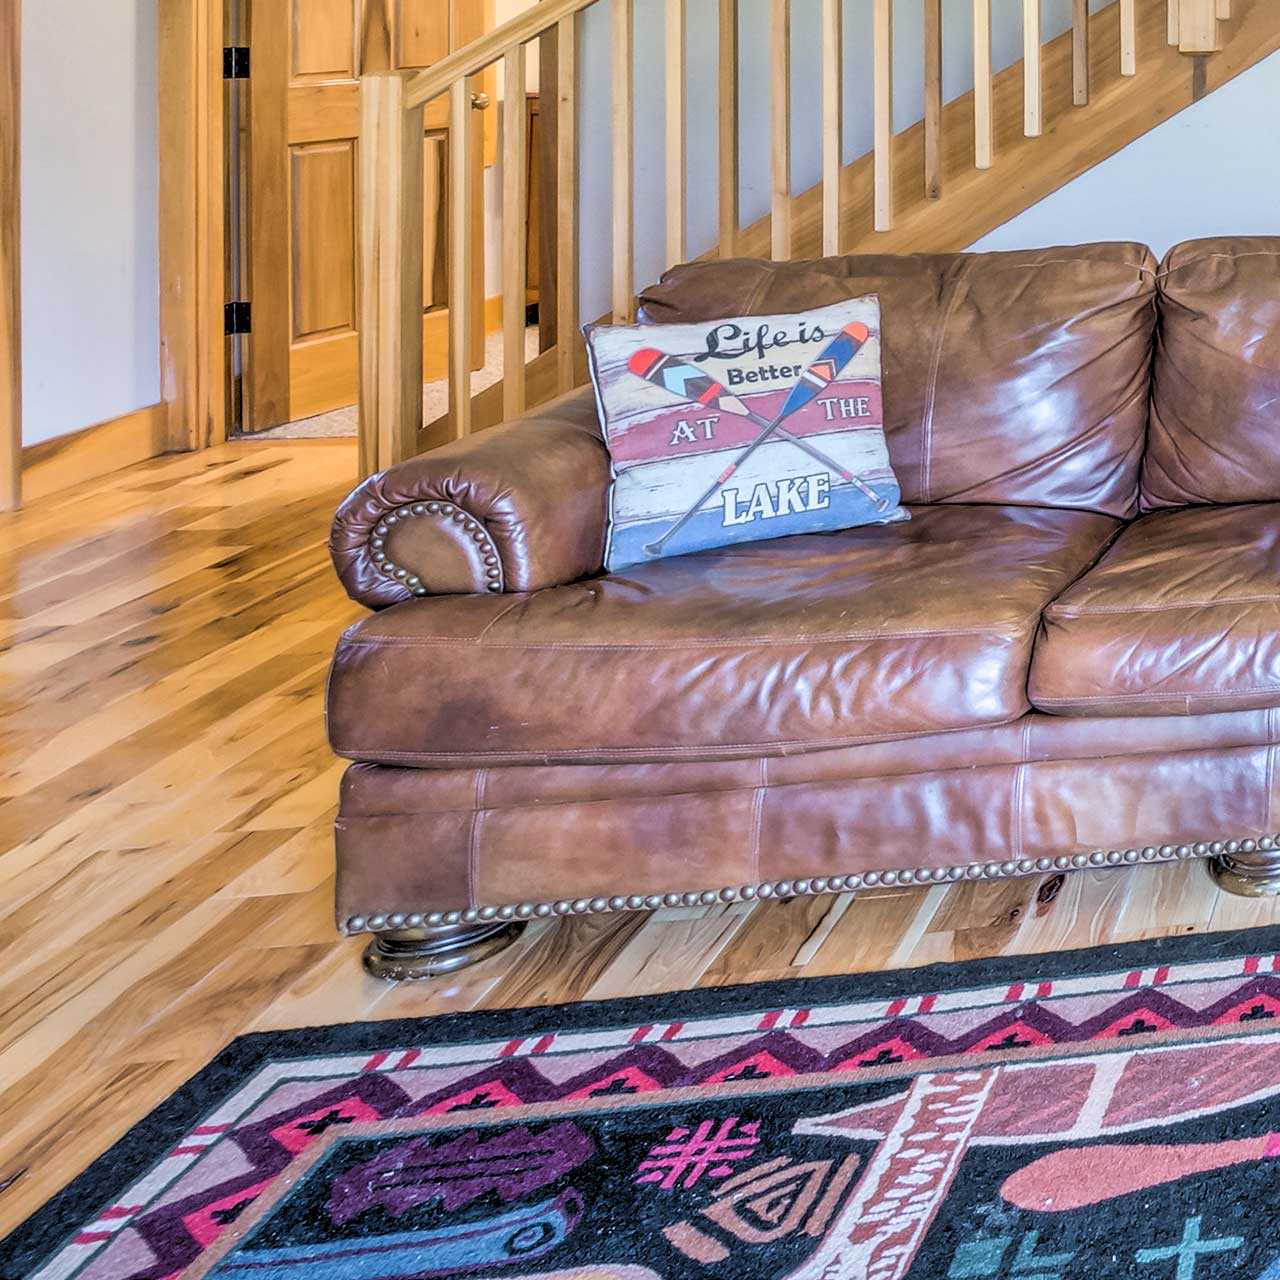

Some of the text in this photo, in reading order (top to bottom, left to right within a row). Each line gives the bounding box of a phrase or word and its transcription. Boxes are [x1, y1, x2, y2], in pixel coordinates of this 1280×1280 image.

[694, 322, 825, 362] Life is
[727, 364, 802, 386] Better
[670, 397, 872, 445] AT THE
[721, 472, 831, 527] LAKE
